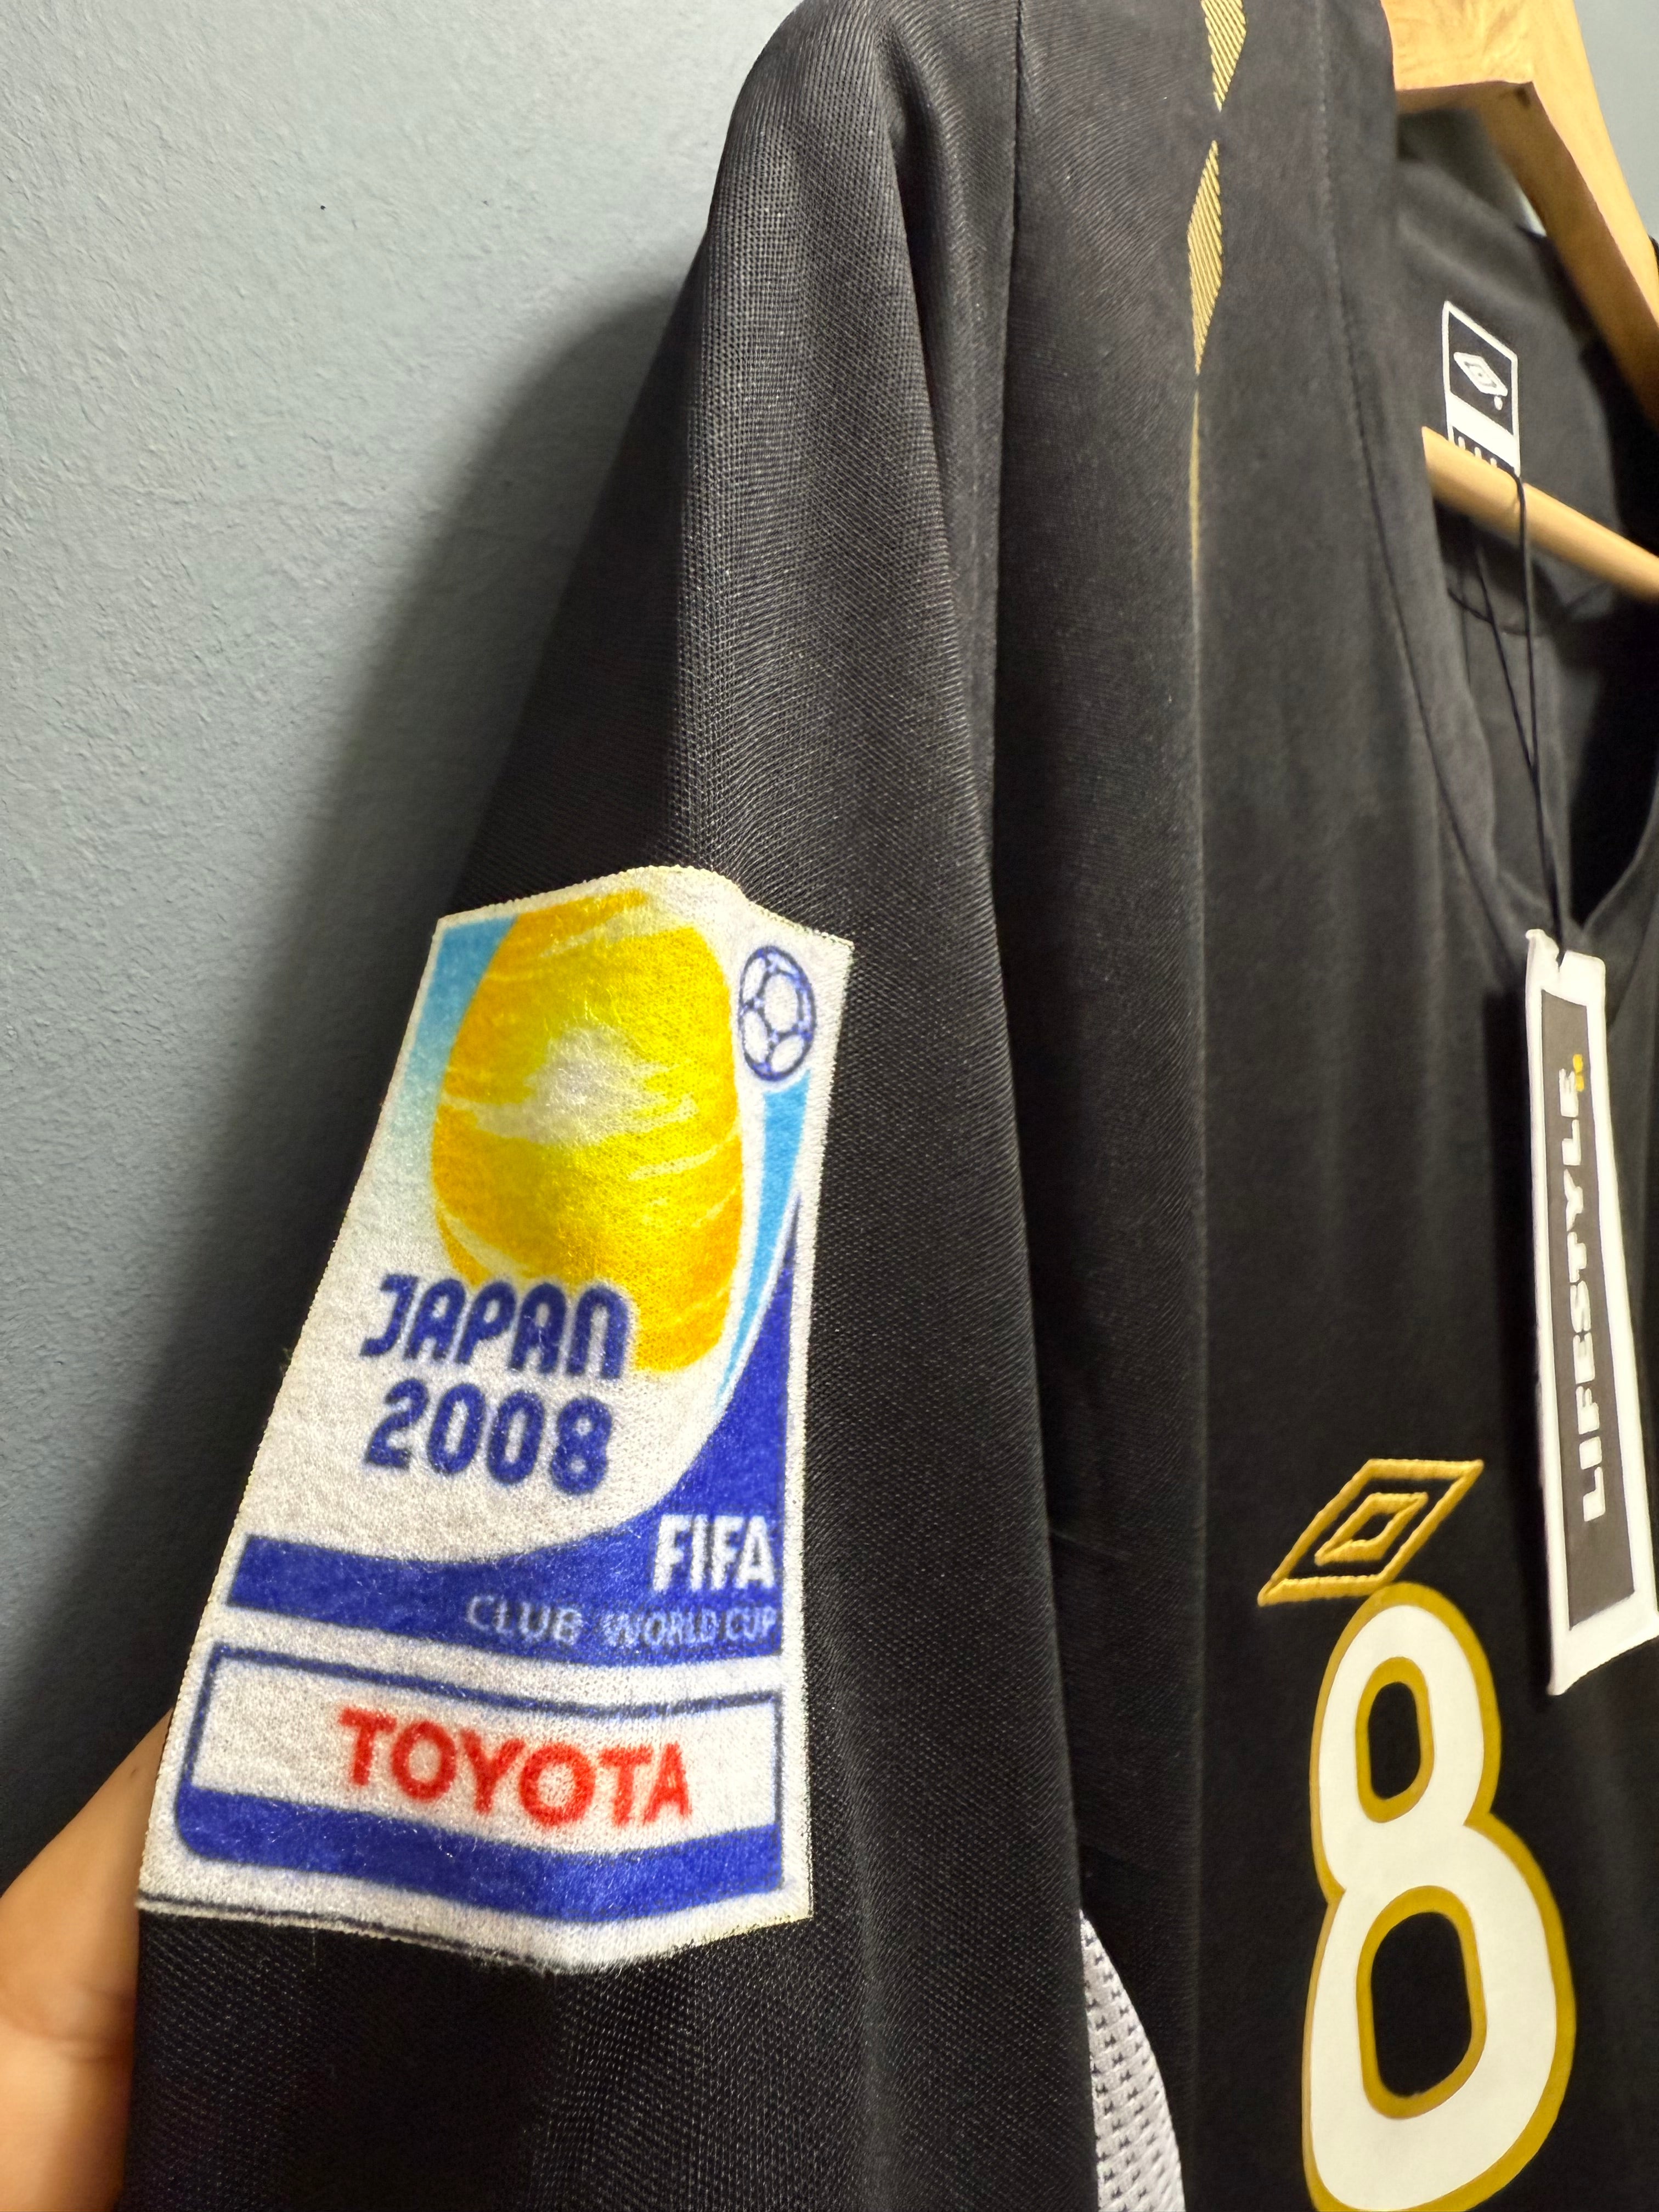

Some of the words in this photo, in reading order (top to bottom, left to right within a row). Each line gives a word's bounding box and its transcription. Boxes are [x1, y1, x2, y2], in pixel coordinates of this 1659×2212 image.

[360, 1274, 630, 1381] JAPAN
[364, 1378, 613, 1496] 2008
[652, 1514, 775, 1592] FIFA
[466, 1594, 583, 1646] CLUB
[602, 1607, 718, 1647] WORLD
[725, 1605, 777, 1641] CUP
[338, 1705, 693, 1829] TOYOTA
[1301, 1581, 1576, 2212] 8
